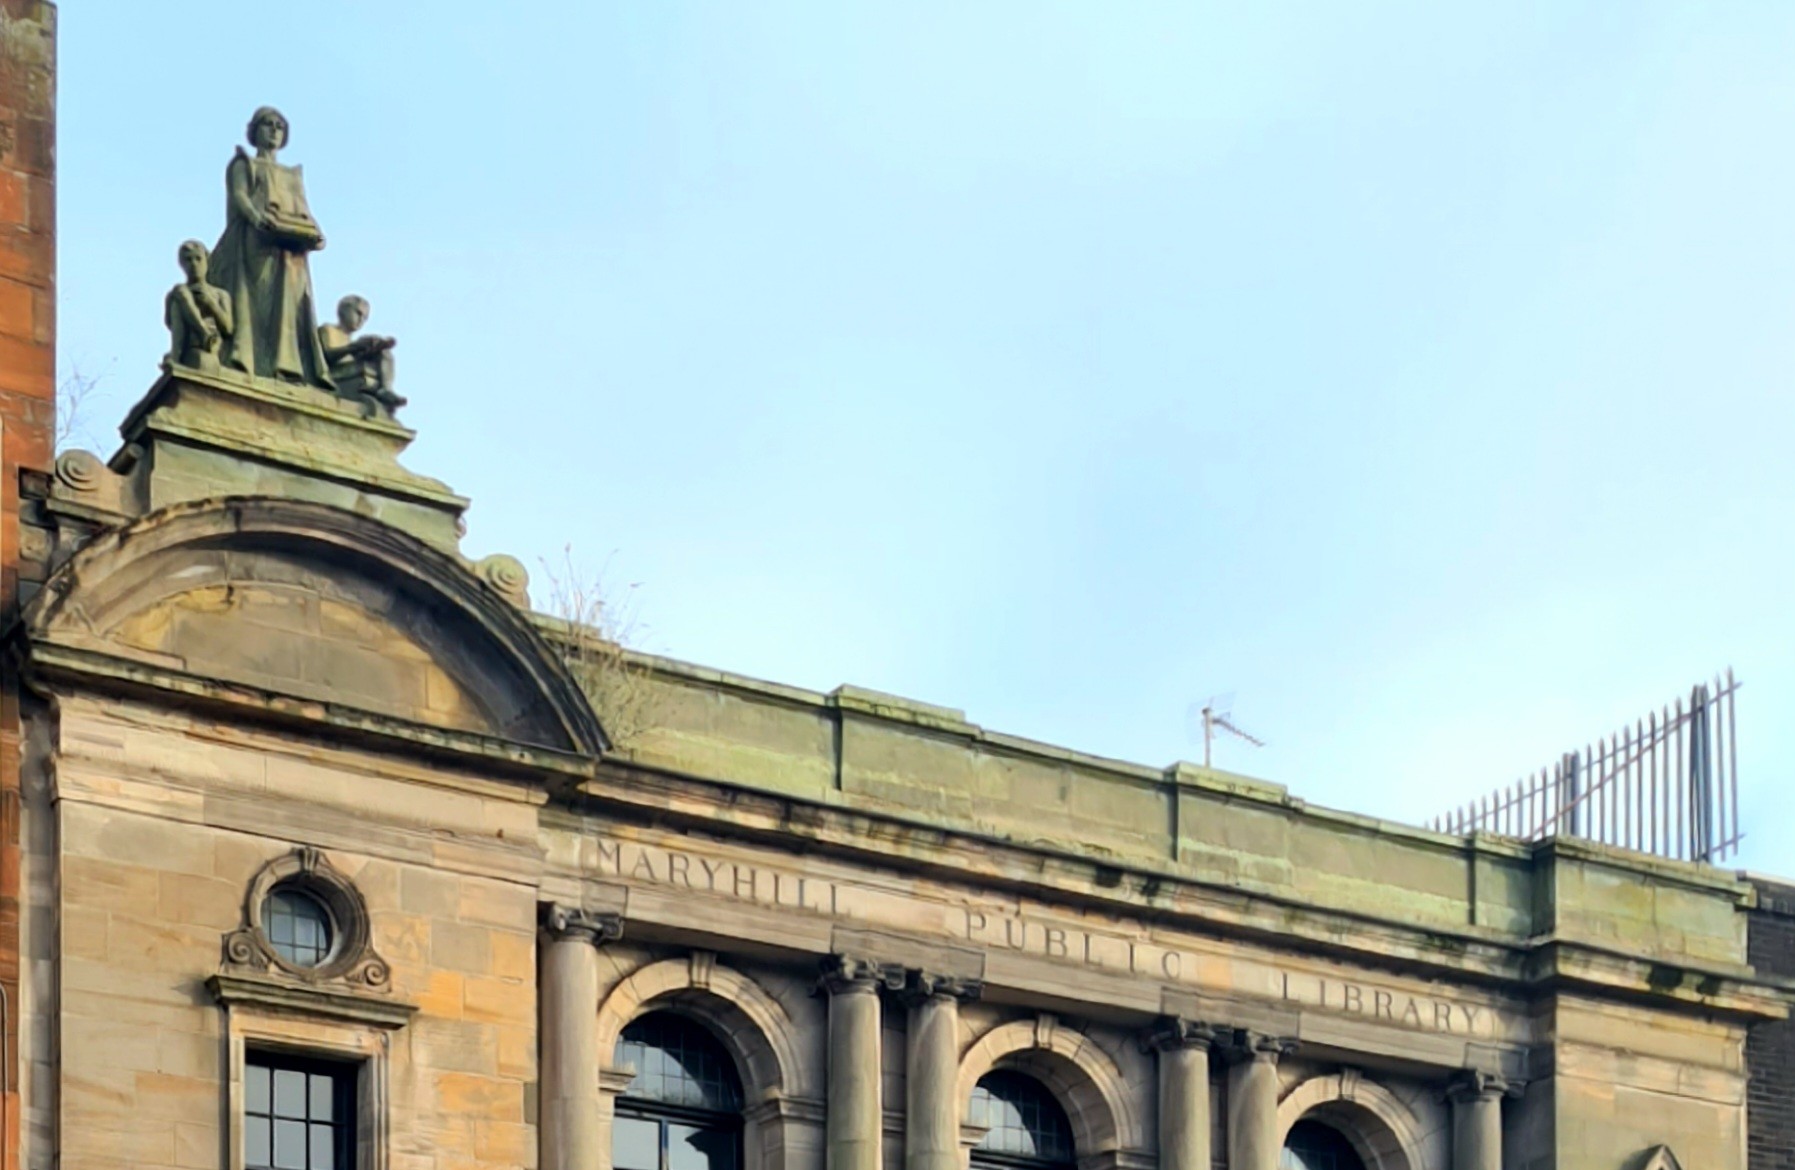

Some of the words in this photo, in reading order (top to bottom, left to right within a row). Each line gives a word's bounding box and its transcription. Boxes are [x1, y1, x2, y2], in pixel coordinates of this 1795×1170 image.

[596, 840, 851, 917] MARYHILL
[965, 912, 1181, 980] PUBLIC
[1280, 971, 1479, 1034] LIBRARY
